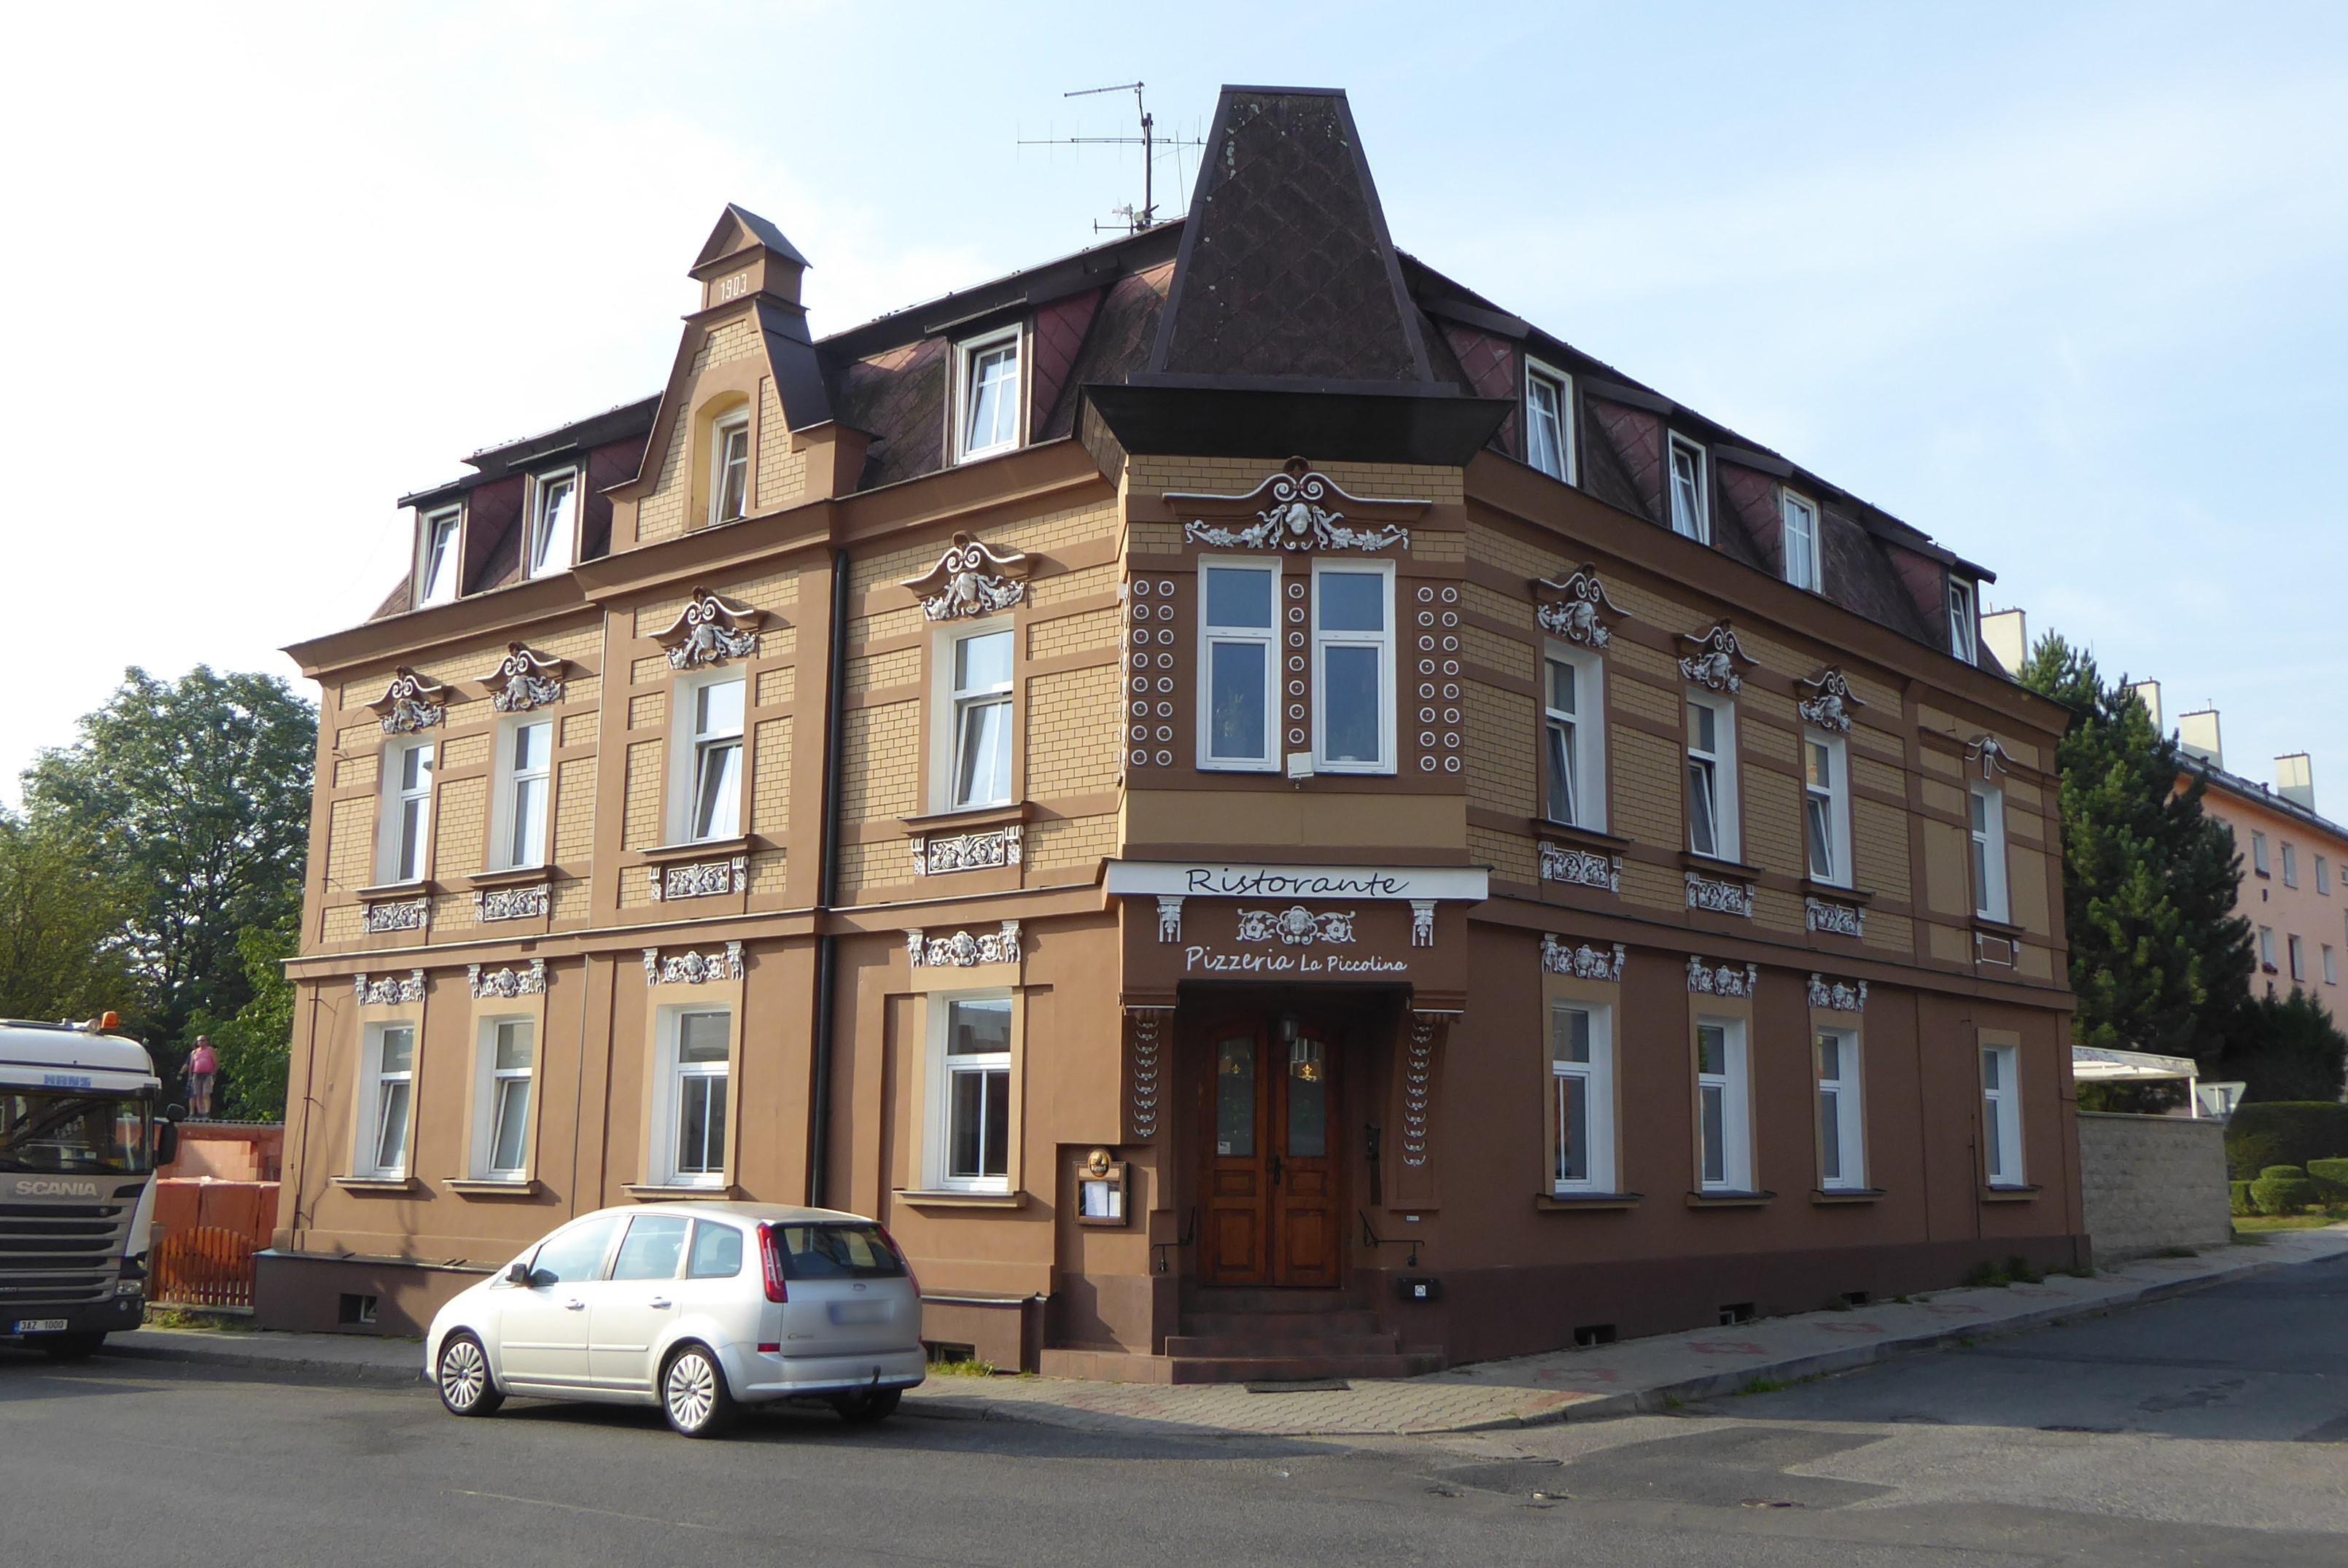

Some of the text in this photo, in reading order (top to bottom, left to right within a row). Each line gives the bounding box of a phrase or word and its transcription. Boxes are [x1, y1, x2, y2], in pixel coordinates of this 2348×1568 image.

[720, 273, 747, 300] 1903
[1186, 867, 1410, 896] Ristorante
[1185, 946, 1407, 972] Pizzeria La Piccolina
[16, 1181, 97, 1195] SCANIA
